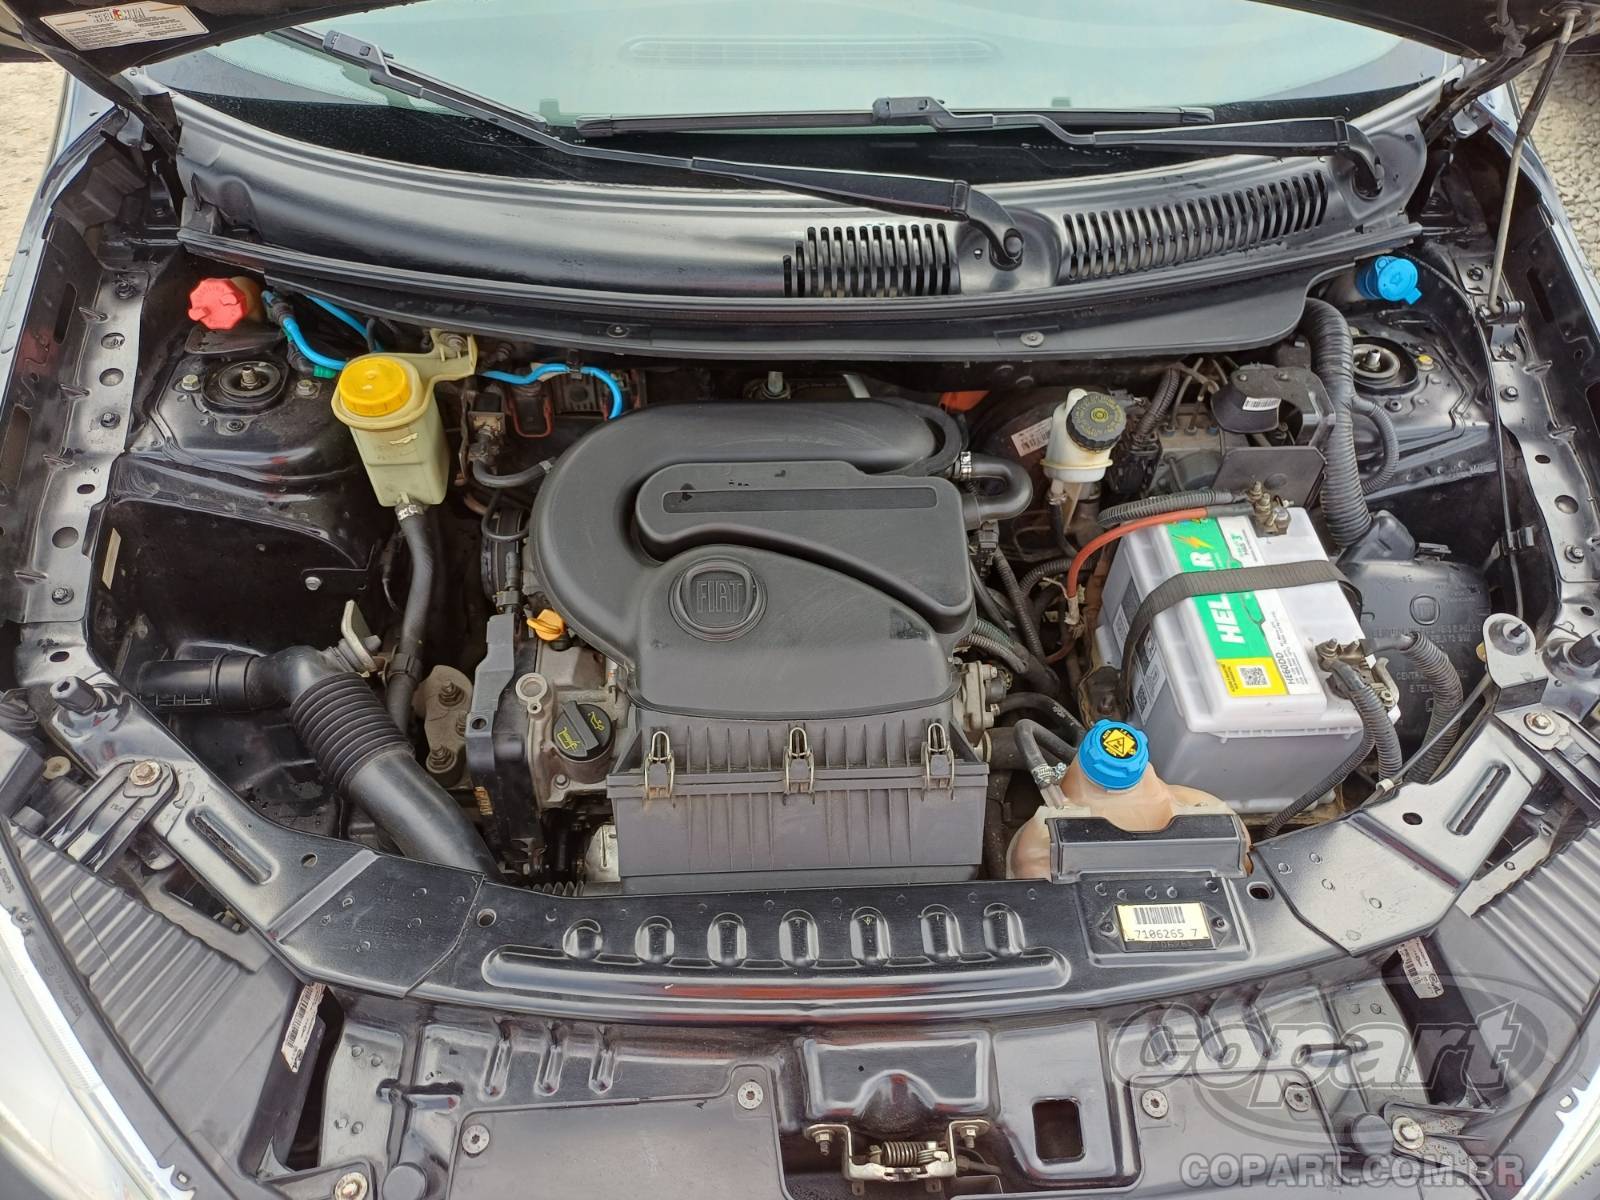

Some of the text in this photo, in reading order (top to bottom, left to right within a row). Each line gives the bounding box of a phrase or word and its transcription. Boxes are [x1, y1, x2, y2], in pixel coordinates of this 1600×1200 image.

[696, 580, 743, 613] FIAT
[1134, 928, 1198, 939] 7106265 7
